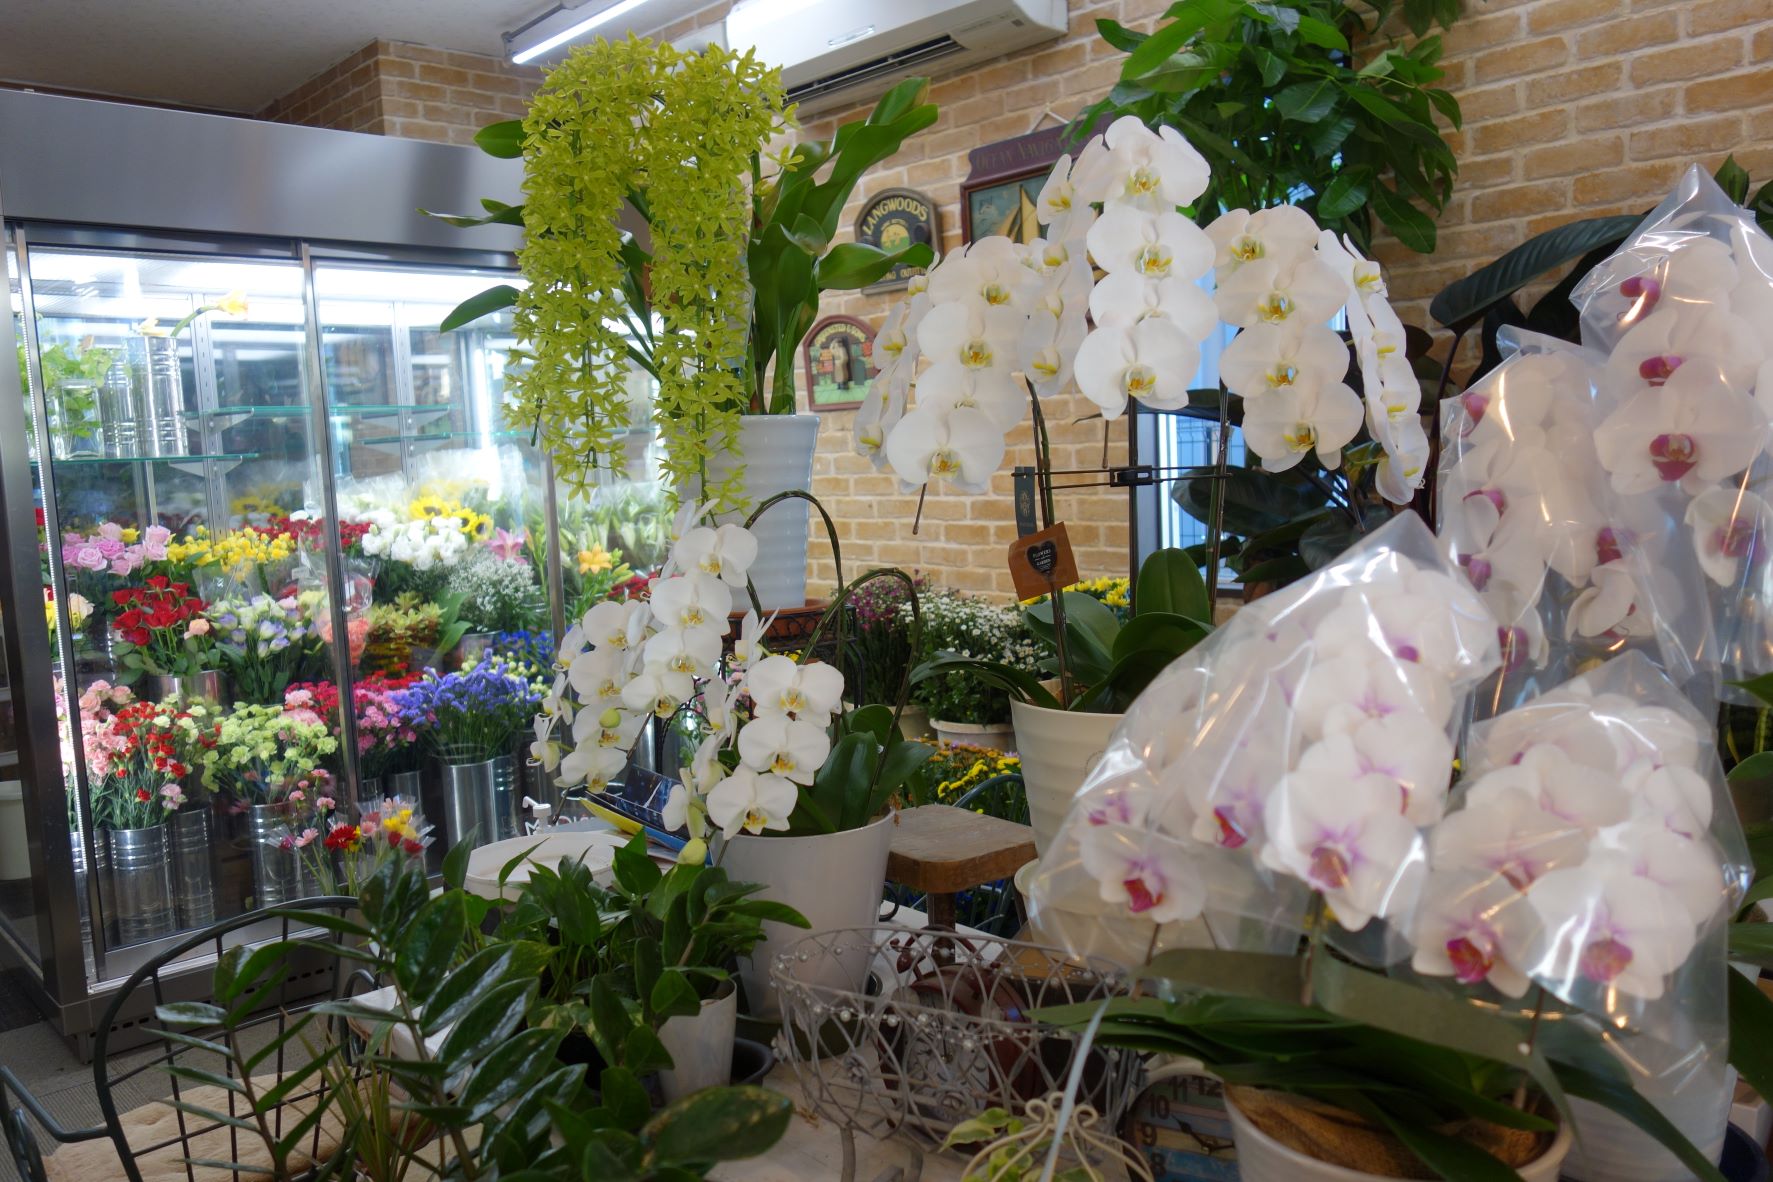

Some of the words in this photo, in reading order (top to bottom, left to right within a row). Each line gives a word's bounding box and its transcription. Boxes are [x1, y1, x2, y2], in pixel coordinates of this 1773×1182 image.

[862, 197, 929, 235] LANGWOODS
[1168, 1076, 1188, 1102] 11
[1149, 1094, 1170, 1120] 10
[1141, 1122, 1157, 1147] 9
